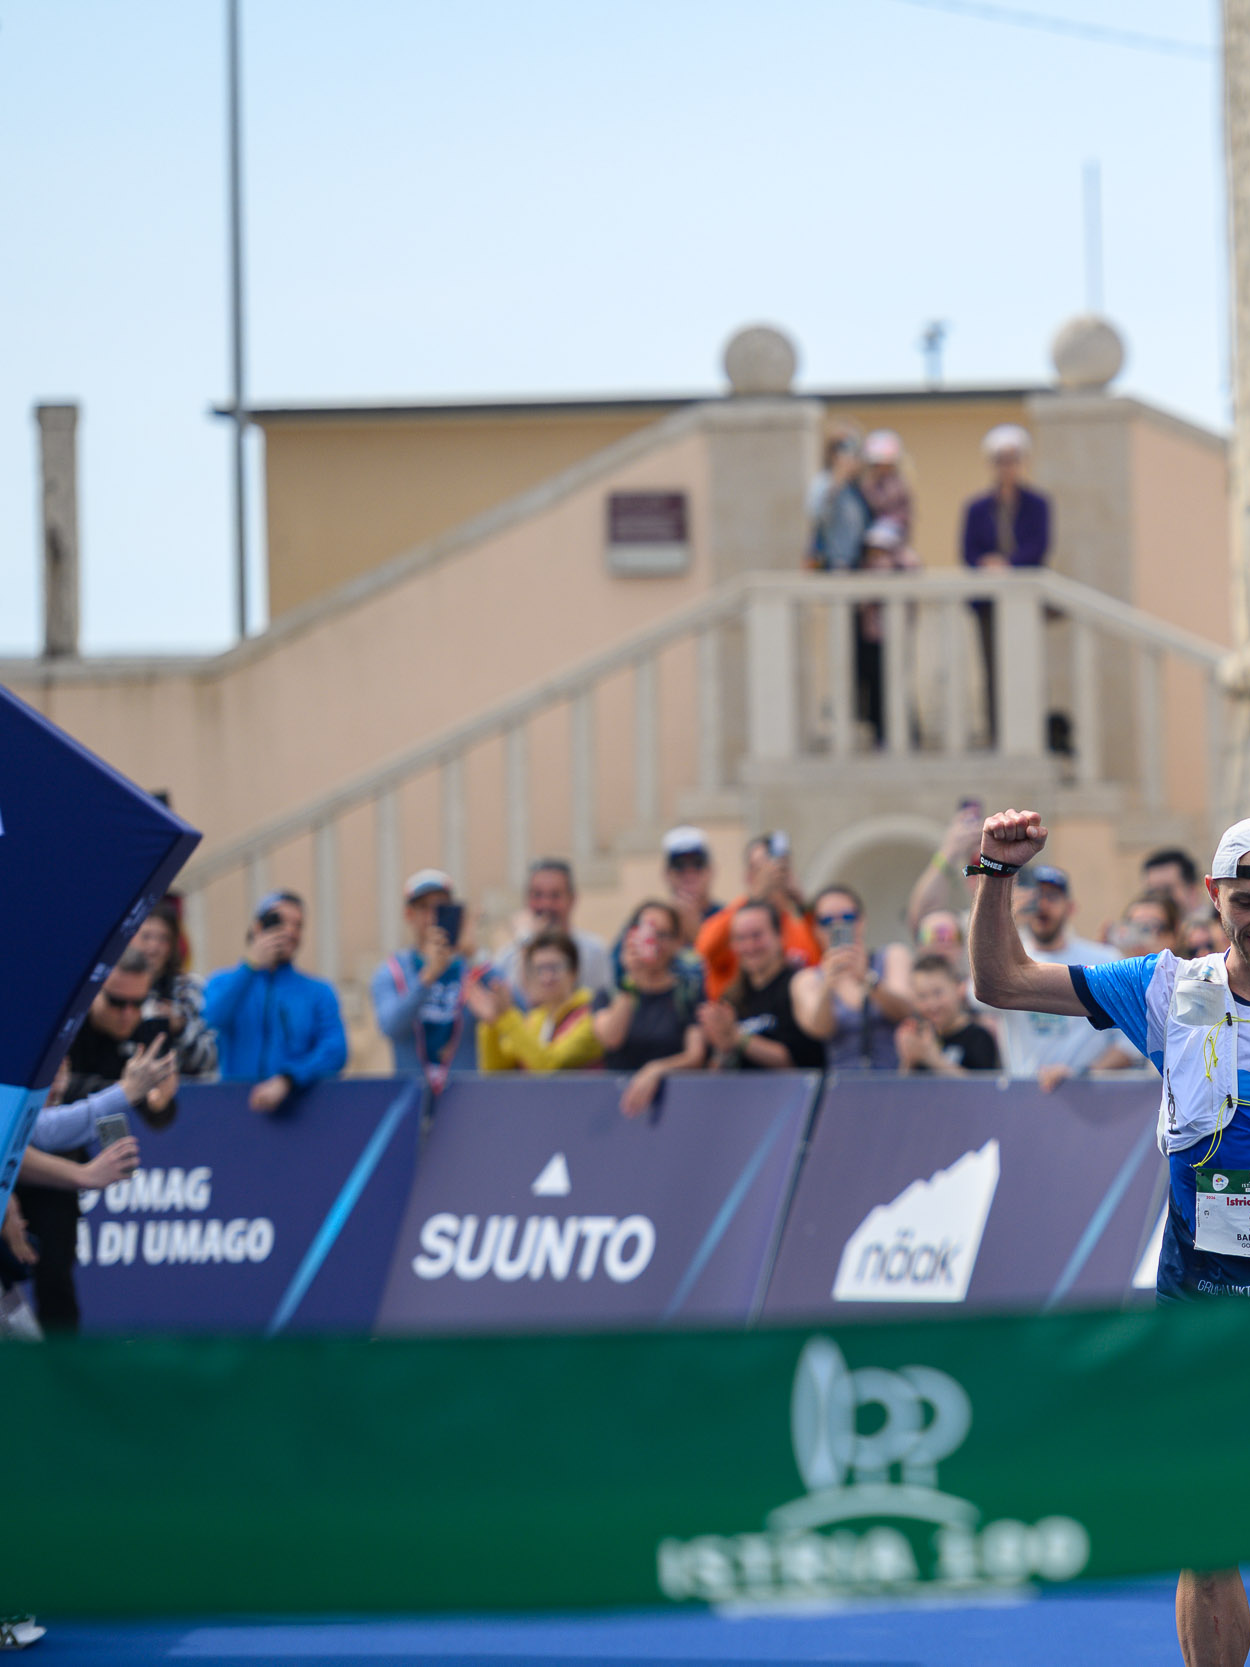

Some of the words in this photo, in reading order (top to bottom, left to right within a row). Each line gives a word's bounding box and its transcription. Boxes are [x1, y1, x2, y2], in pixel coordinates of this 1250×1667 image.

[104, 1166, 212, 1213] UMAG
[97, 1221, 139, 1266] DI
[142, 1217, 274, 1264] UMAGO
[412, 1213, 656, 1284] SUUNTO
